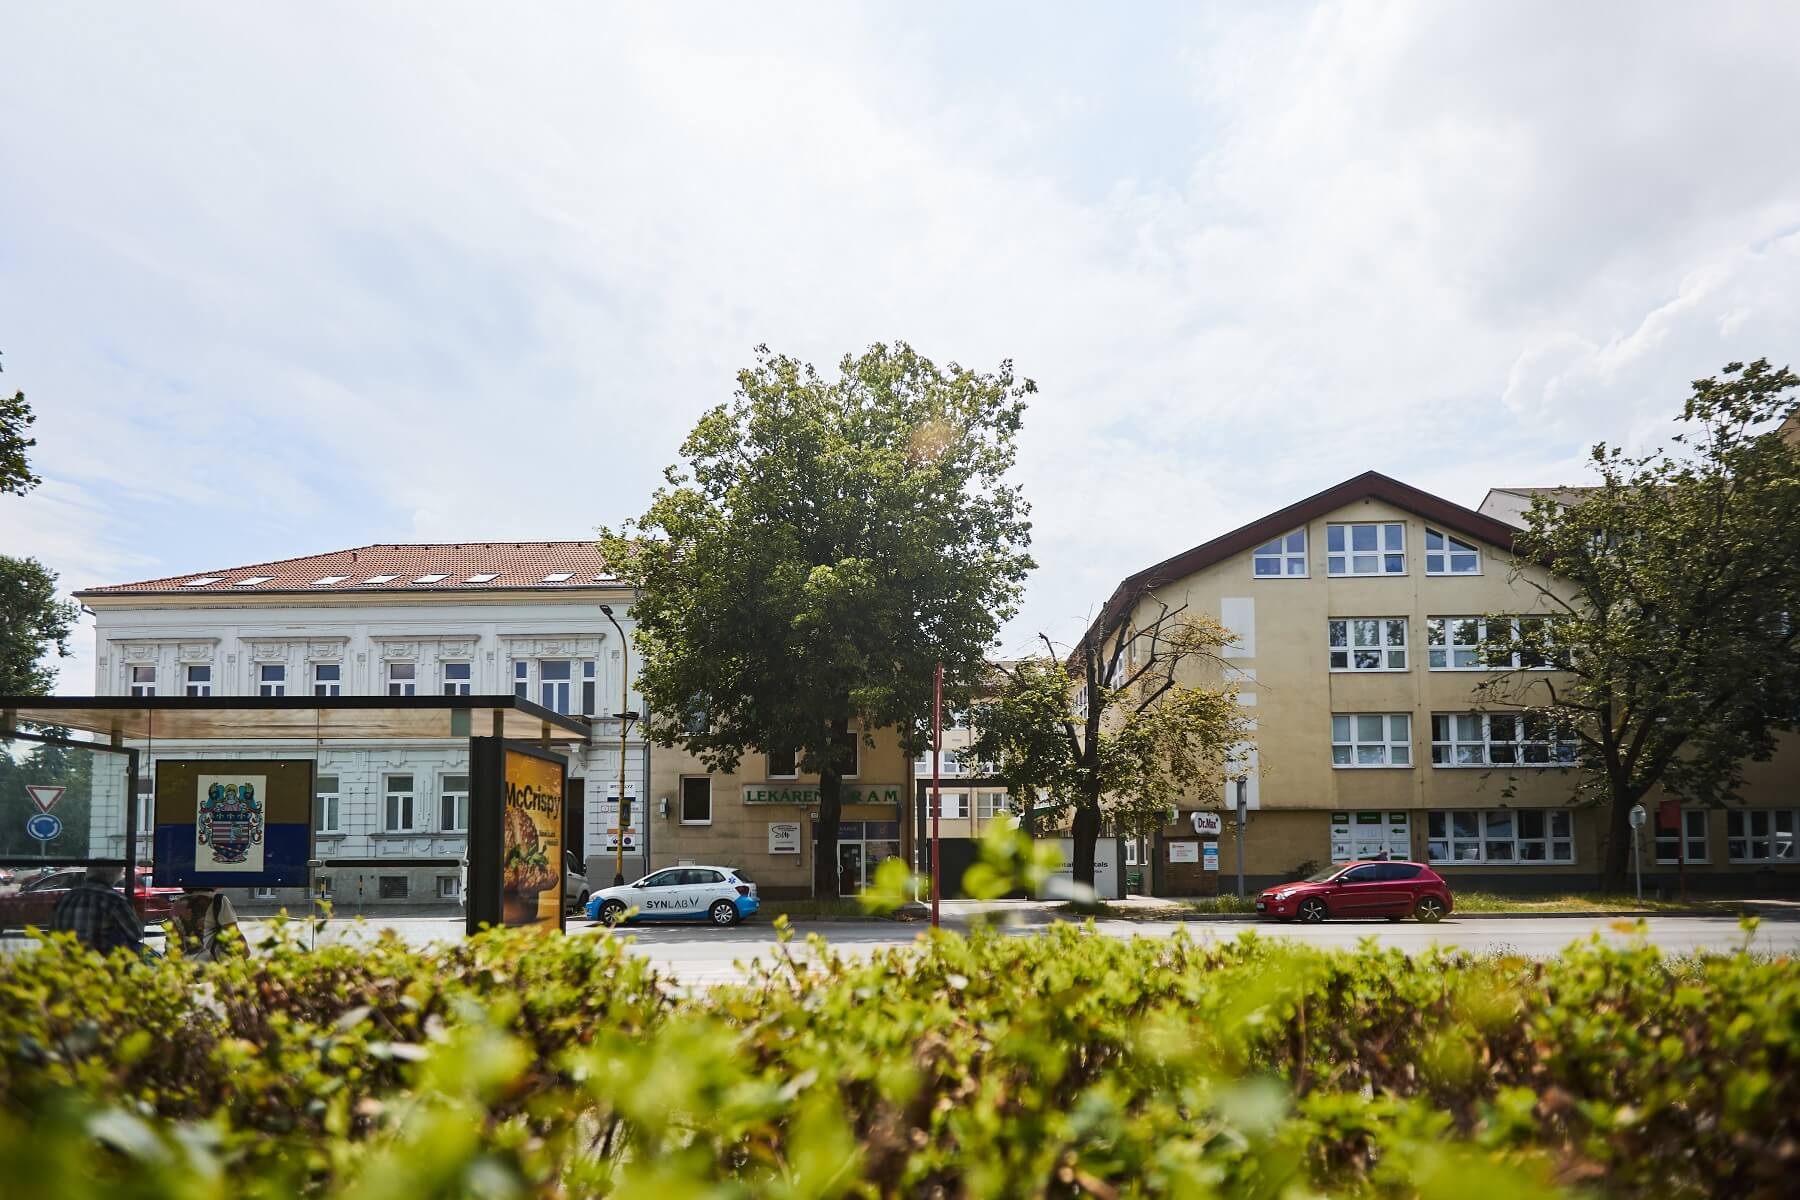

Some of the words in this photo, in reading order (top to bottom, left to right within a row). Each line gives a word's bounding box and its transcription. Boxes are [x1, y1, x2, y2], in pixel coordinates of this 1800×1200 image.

[504, 781, 560, 819] McCrispy
[850, 790, 898, 801] RAM
[646, 899, 688, 909] SYNLAB
